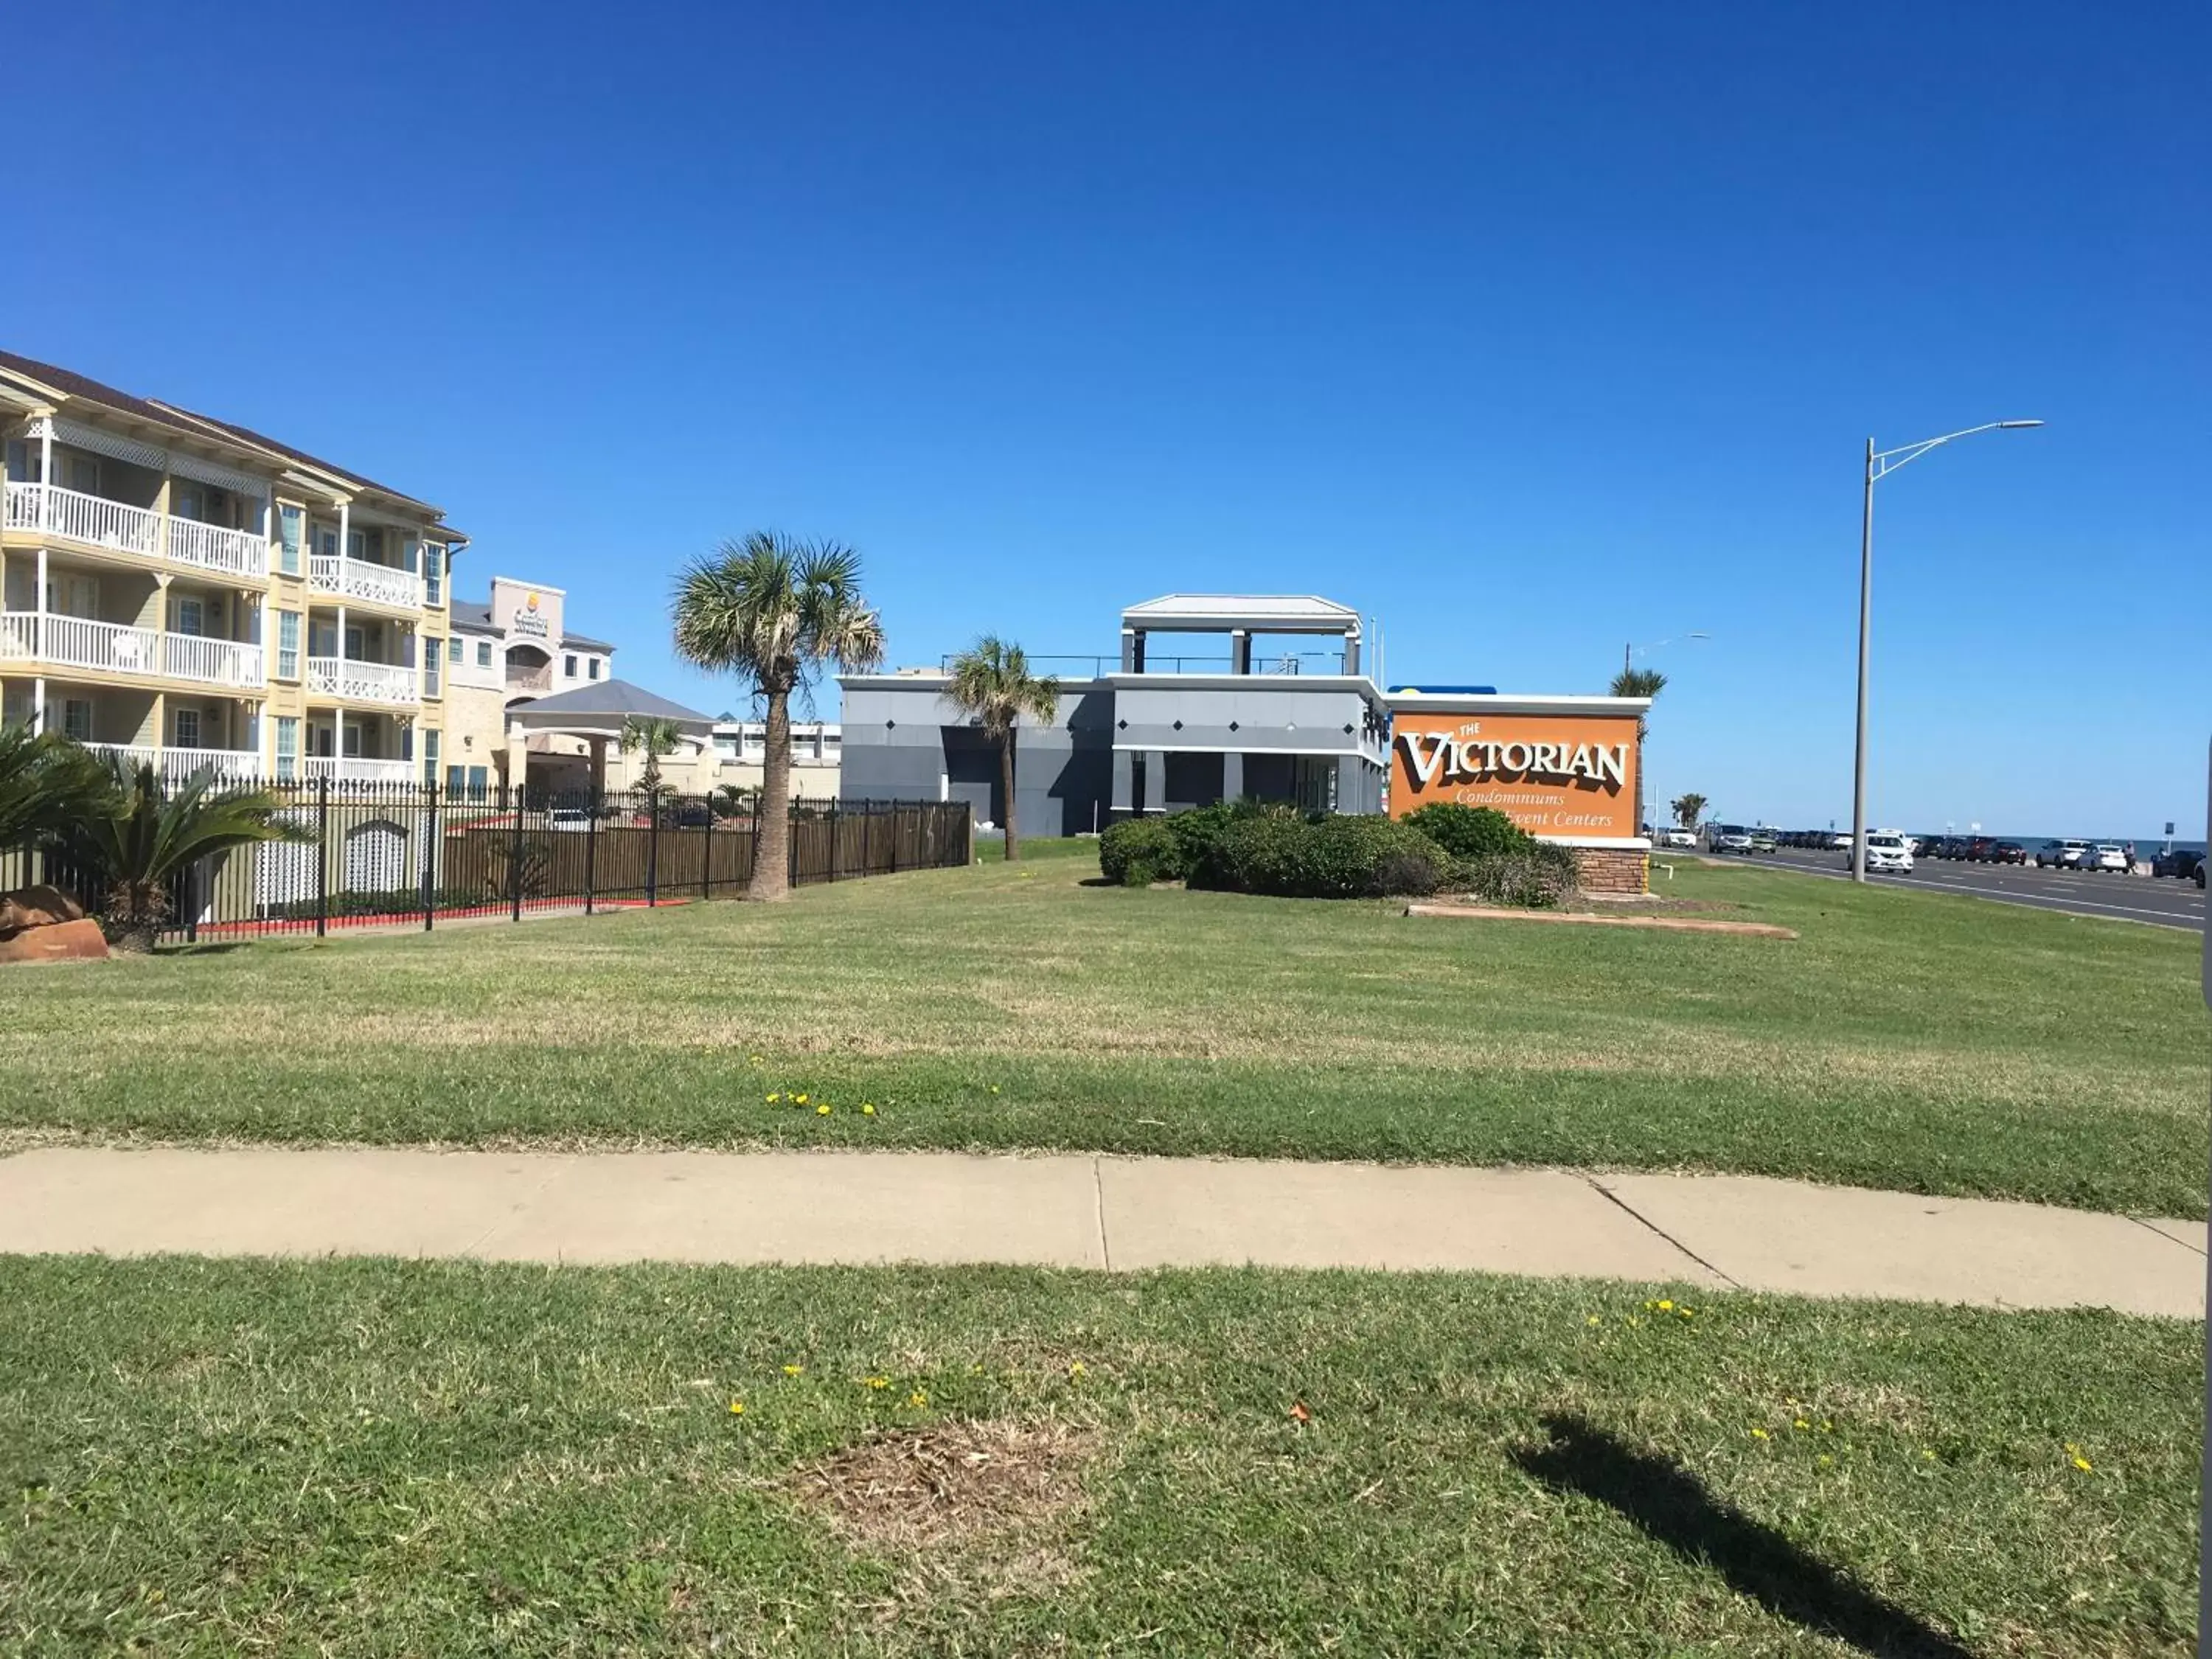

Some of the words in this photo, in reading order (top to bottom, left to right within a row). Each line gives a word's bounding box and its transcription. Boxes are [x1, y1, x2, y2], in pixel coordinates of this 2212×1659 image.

[1459, 722, 1481, 737] THE
[1398, 731, 1630, 787] VICTORIAN
[1455, 789, 1565, 806] Condominiums
[1554, 811, 1613, 827] Centers
